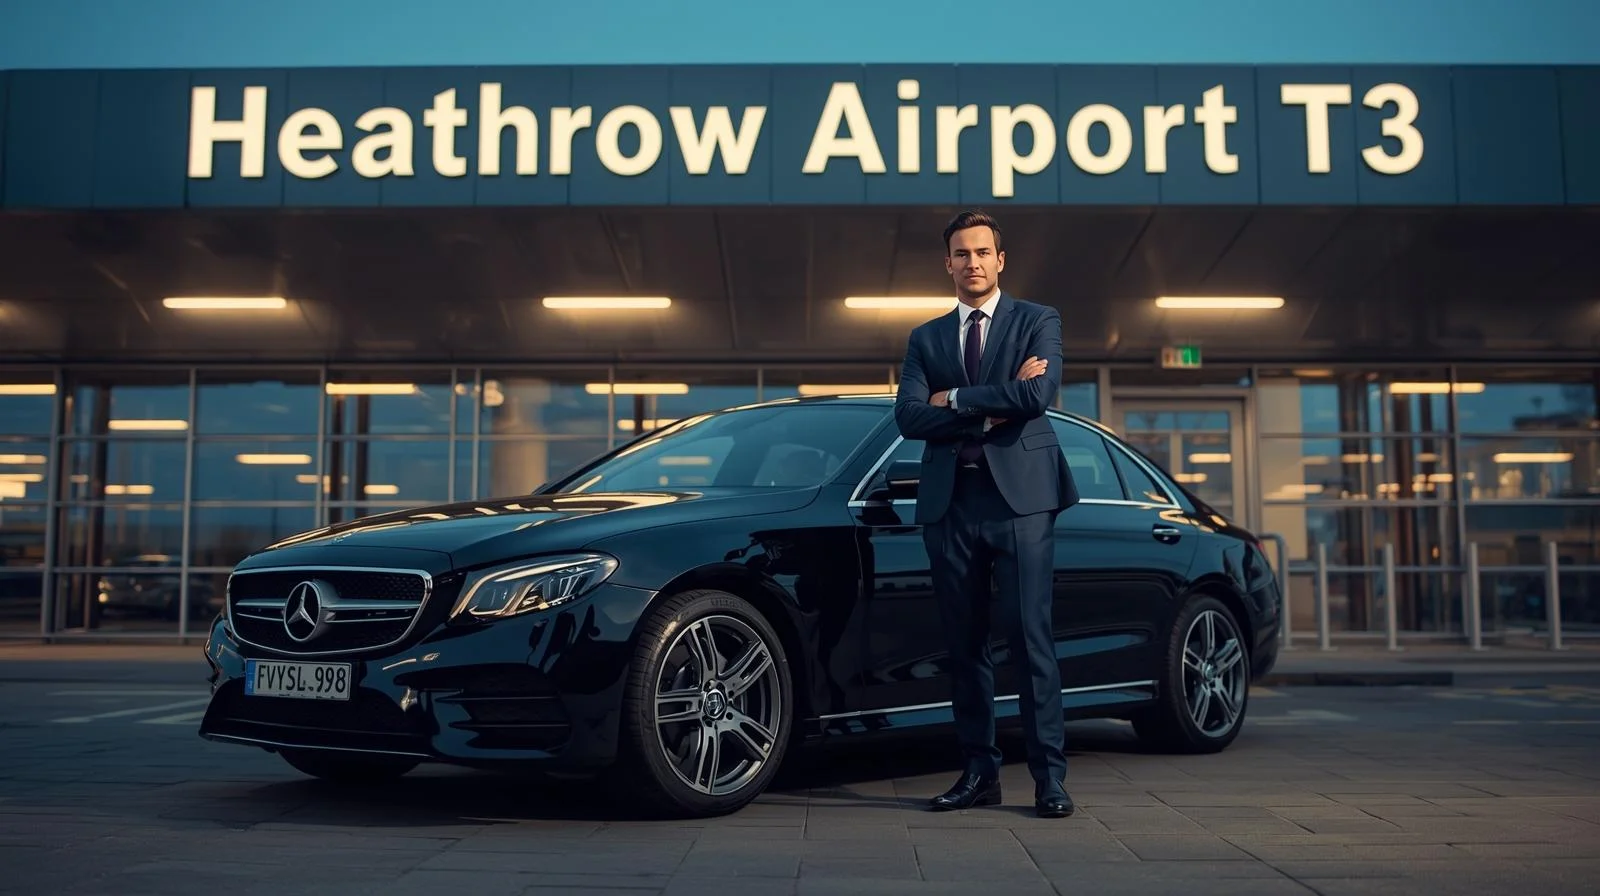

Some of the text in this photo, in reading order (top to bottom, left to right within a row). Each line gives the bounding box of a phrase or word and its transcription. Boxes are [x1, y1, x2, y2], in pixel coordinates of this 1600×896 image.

[188, 79, 1424, 197] Heathrow Airport T3
